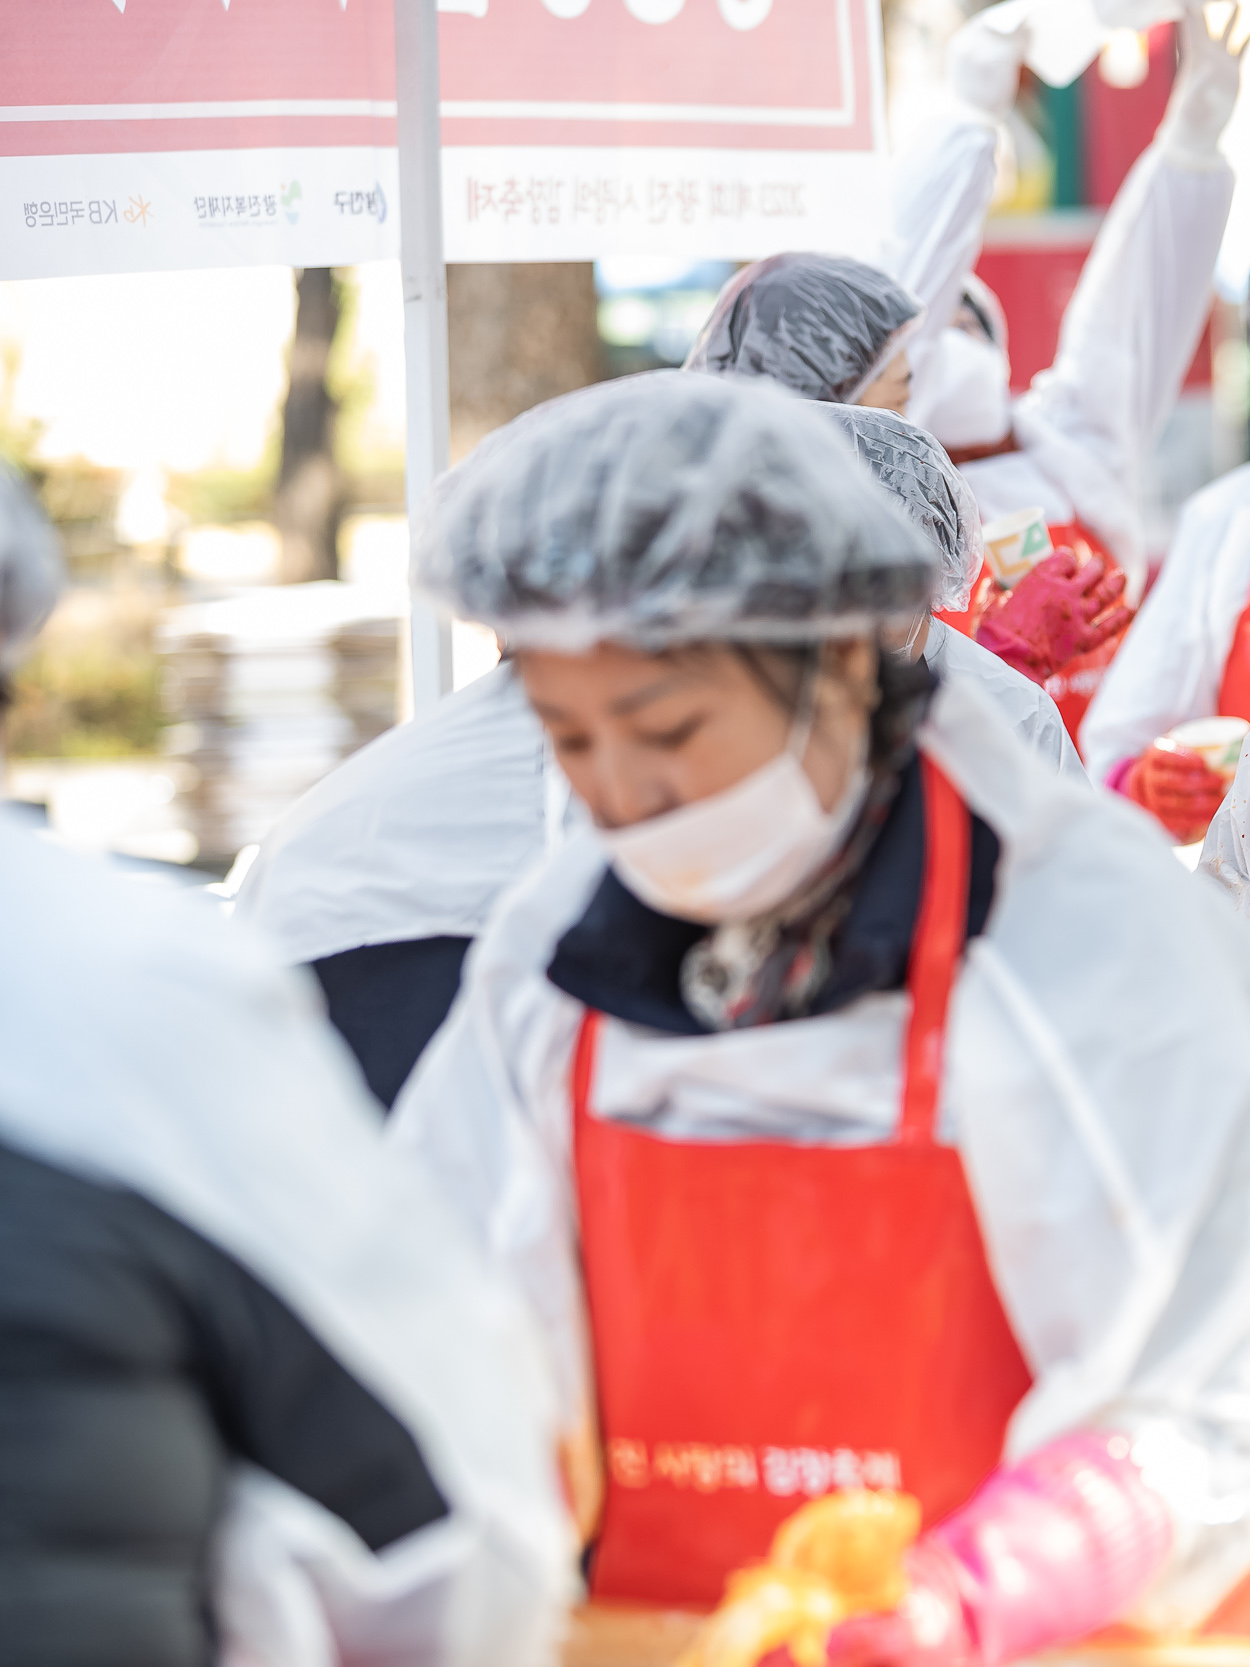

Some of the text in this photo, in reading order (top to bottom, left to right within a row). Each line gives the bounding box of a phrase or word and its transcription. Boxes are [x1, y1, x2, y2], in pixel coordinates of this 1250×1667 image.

[611, 1438, 902, 1499] 진 사랑의 김장축제
